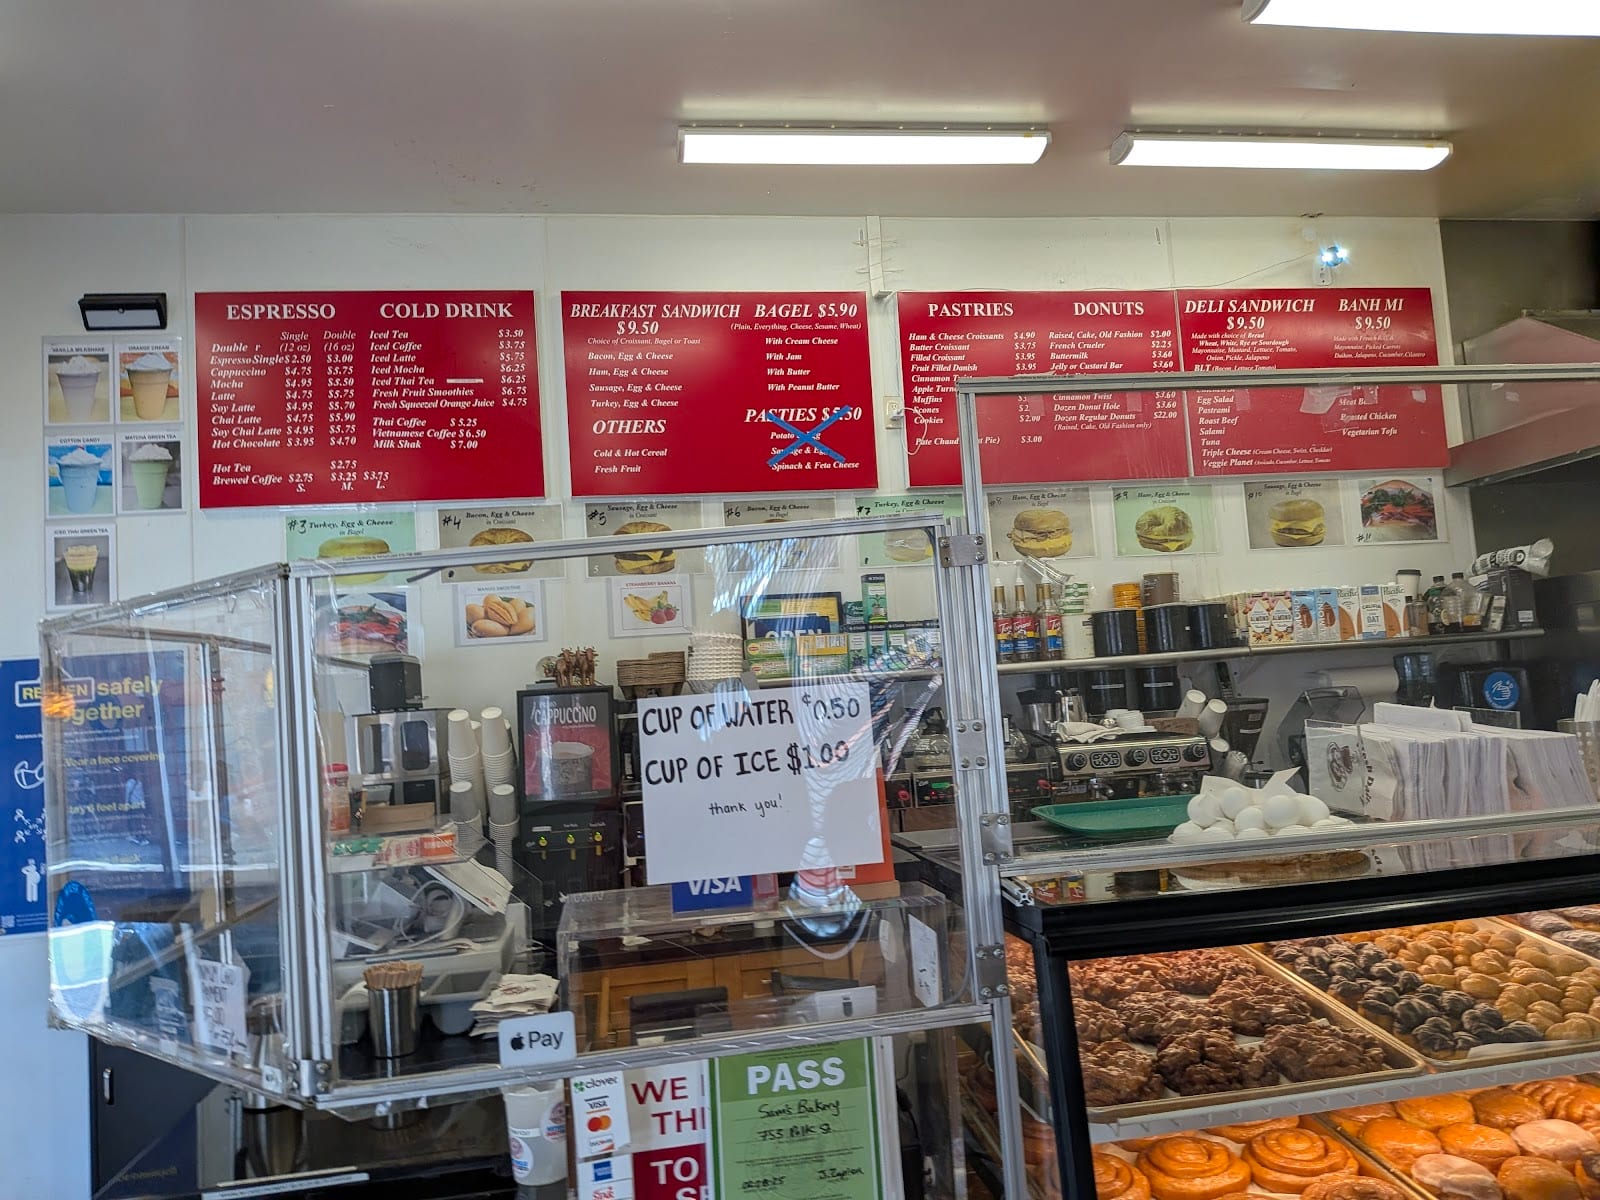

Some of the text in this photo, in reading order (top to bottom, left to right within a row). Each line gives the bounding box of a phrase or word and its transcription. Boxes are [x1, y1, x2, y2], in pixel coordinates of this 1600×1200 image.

[380, 303, 514, 318] COLD DRINK
[570, 304, 740, 318] BREAKFAST SANDWICH
[754, 303, 857, 318] BAGEL $5.90
[928, 303, 1014, 317] PASTRIES
[1074, 302, 1144, 316] DONUTS
[1184, 299, 1315, 313] DELI SANDWICH
[1338, 299, 1404, 311] BANH MI
[227, 304, 335, 320] ESPRESSO
[617, 321, 659, 335] $9.50
[1227, 316, 1264, 330] $9.50
[1355, 316, 1390, 329] $9.50
[280, 332, 308, 341] Single
[324, 331, 356, 340] Double
[370, 329, 524, 339] Iced Tea $3.50
[967, 332, 1004, 340] Croissants
[1014, 332, 1035, 340] $4.90
[370, 341, 525, 352] Iced Coffee $3.75
[785, 337, 809, 345] Cream
[812, 337, 838, 345] Cheese
[1050, 342, 1075, 350] French
[210, 354, 353, 366] Espresso Single $2.50 $3.00
[588, 352, 673, 361] Bacon, Egg & Cheese
[910, 354, 931, 362] Filled
[1050, 352, 1088, 360] Buttermilk
[210, 366, 353, 378] Cappuccino $4.75 $5.75
[589, 368, 610, 376] Ham,
[613, 368, 628, 377] Egg
[641, 368, 668, 376] Cheese
[767, 368, 810, 376] With Butter
[211, 380, 243, 389] Mocha
[285, 379, 312, 388] $4.95
[372, 387, 527, 398] Fresh Fruit Smoothies $6.75
[373, 398, 527, 410] Fresh Squeezed Orange Juice $4.75
[913, 396, 942, 405] Muffins
[1197, 396, 1211, 405] Egg
[914, 406, 939, 414] Scones
[1198, 406, 1230, 414] Pastrami
[593, 419, 666, 434] OTHERS
[1222, 416, 1239, 425] Beef
[372, 428, 486, 439] Vietnamese Coffee $6.50
[1200, 427, 1225, 435] Salami
[212, 436, 356, 449] Hot Chocolate $3.95 $4.70
[374, 440, 478, 449] Milk Shak $7.00
[594, 449, 613, 457] Cold
[641, 448, 668, 456] Cereal
[595, 465, 641, 473] Fresh Fruit
[608, 504, 634, 513] Sausage,
[636, 504, 648, 512] Egg
[442, 515, 461, 530] #4
[588, 510, 607, 526] #5
[288, 520, 307, 534] #3
[309, 521, 338, 529] Turkey,
[340, 520, 356, 528] Egg
[1367, 616, 1380, 624] OAT
[97, 675, 163, 696] safely
[535, 705, 596, 725] CAPPUCCINO
[642, 706, 682, 736] CUP
[691, 703, 716, 730] OF
[722, 699, 794, 728] WATER
[646, 740, 849, 785] CUP OF ICE $1.00
[709, 793, 782, 817] thank you!
[688, 876, 742, 895] VISA
[528, 1031, 564, 1049] Pay
[747, 1057, 845, 1095] PASS
[586, 1077, 618, 1089] clover
[631, 1077, 688, 1104] WE
[588, 1100, 608, 1109] VISA
[798, 1099, 840, 1116] Bakery
[650, 1157, 699, 1184] TO
